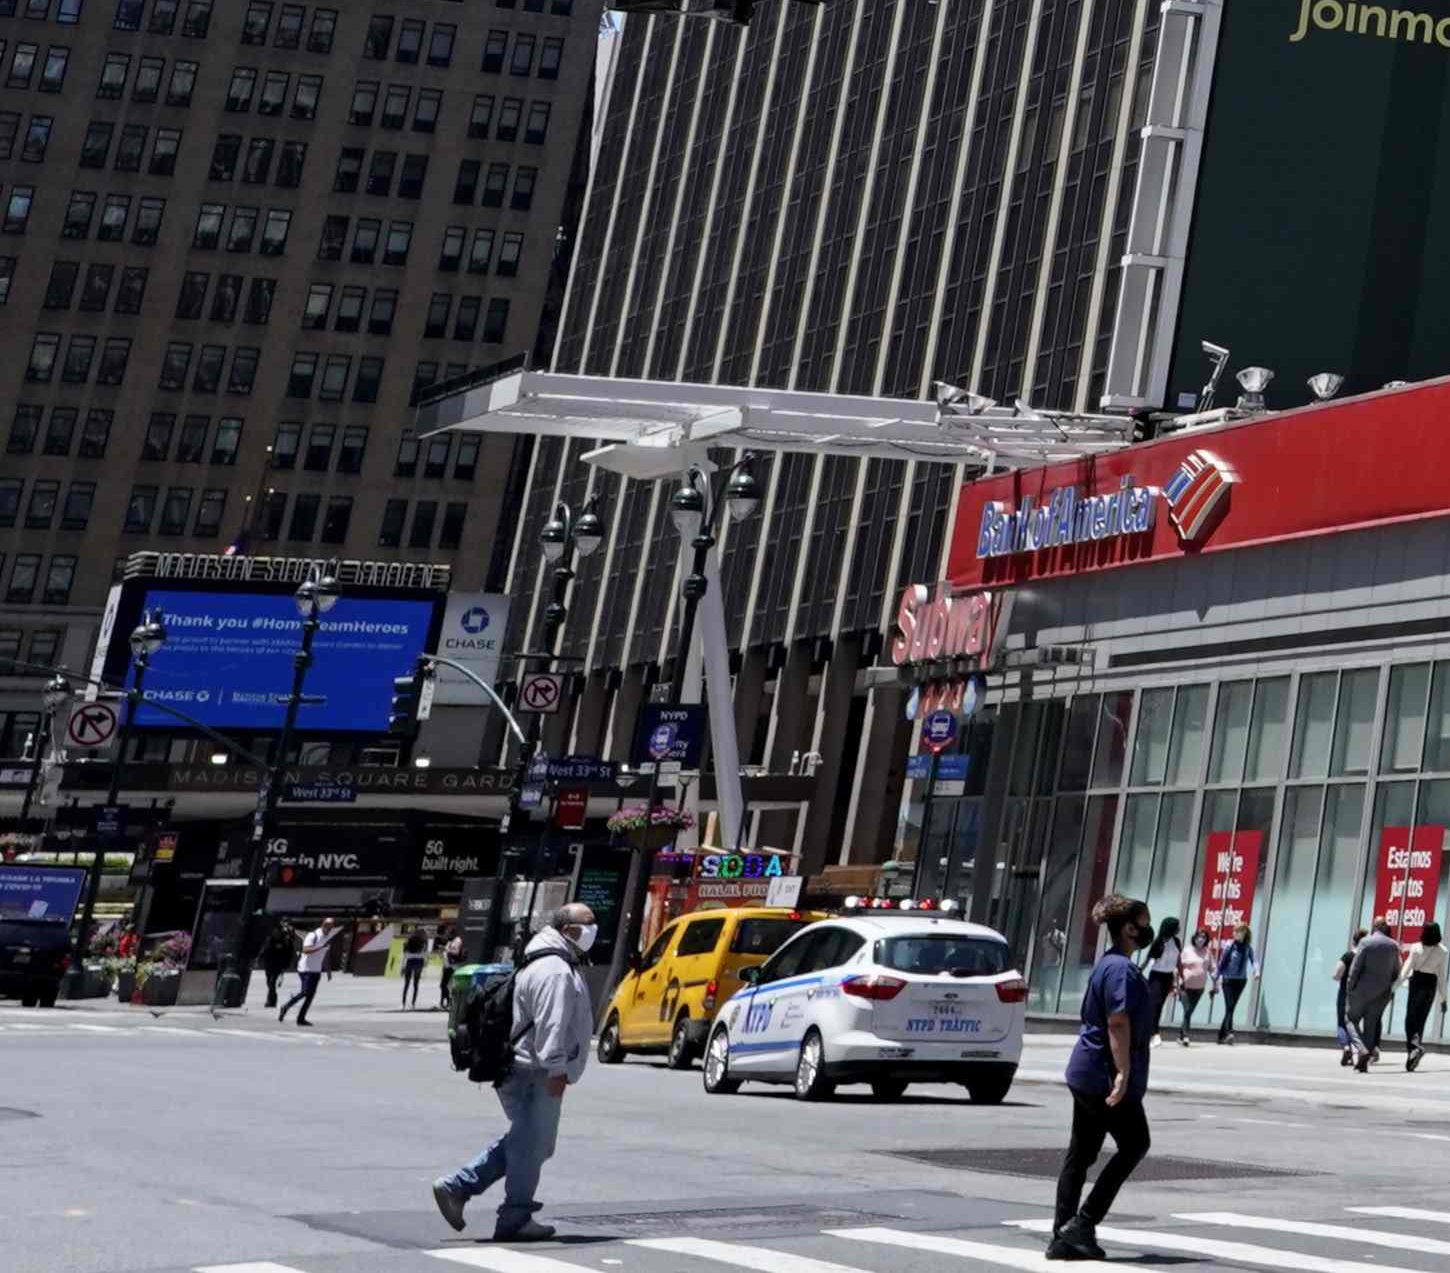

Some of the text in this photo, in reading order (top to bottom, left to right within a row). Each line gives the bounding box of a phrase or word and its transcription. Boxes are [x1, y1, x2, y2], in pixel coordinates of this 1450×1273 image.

[977, 495, 1034, 559] Bank
[1057, 474, 1159, 544] America
[163, 613, 409, 635] Thank you #HomeamHeroes
[446, 638, 496, 650] CHASE
[143, 690, 193, 701] CHASE
[660, 710, 689, 721] NYPD
[600, 765, 612, 777] St
[317, 771, 427, 788] SQUARE
[292, 786, 318, 799] West
[341, 788, 351, 799] St
[425, 839, 444, 855] 5G
[421, 856, 479, 873] built right.
[1387, 846, 1432, 869] Estamos
[702, 854, 783, 878] SODA
[742, 1003, 774, 1034] NYPD
[906, 1018, 981, 1032] NYPD TRAFFIC
